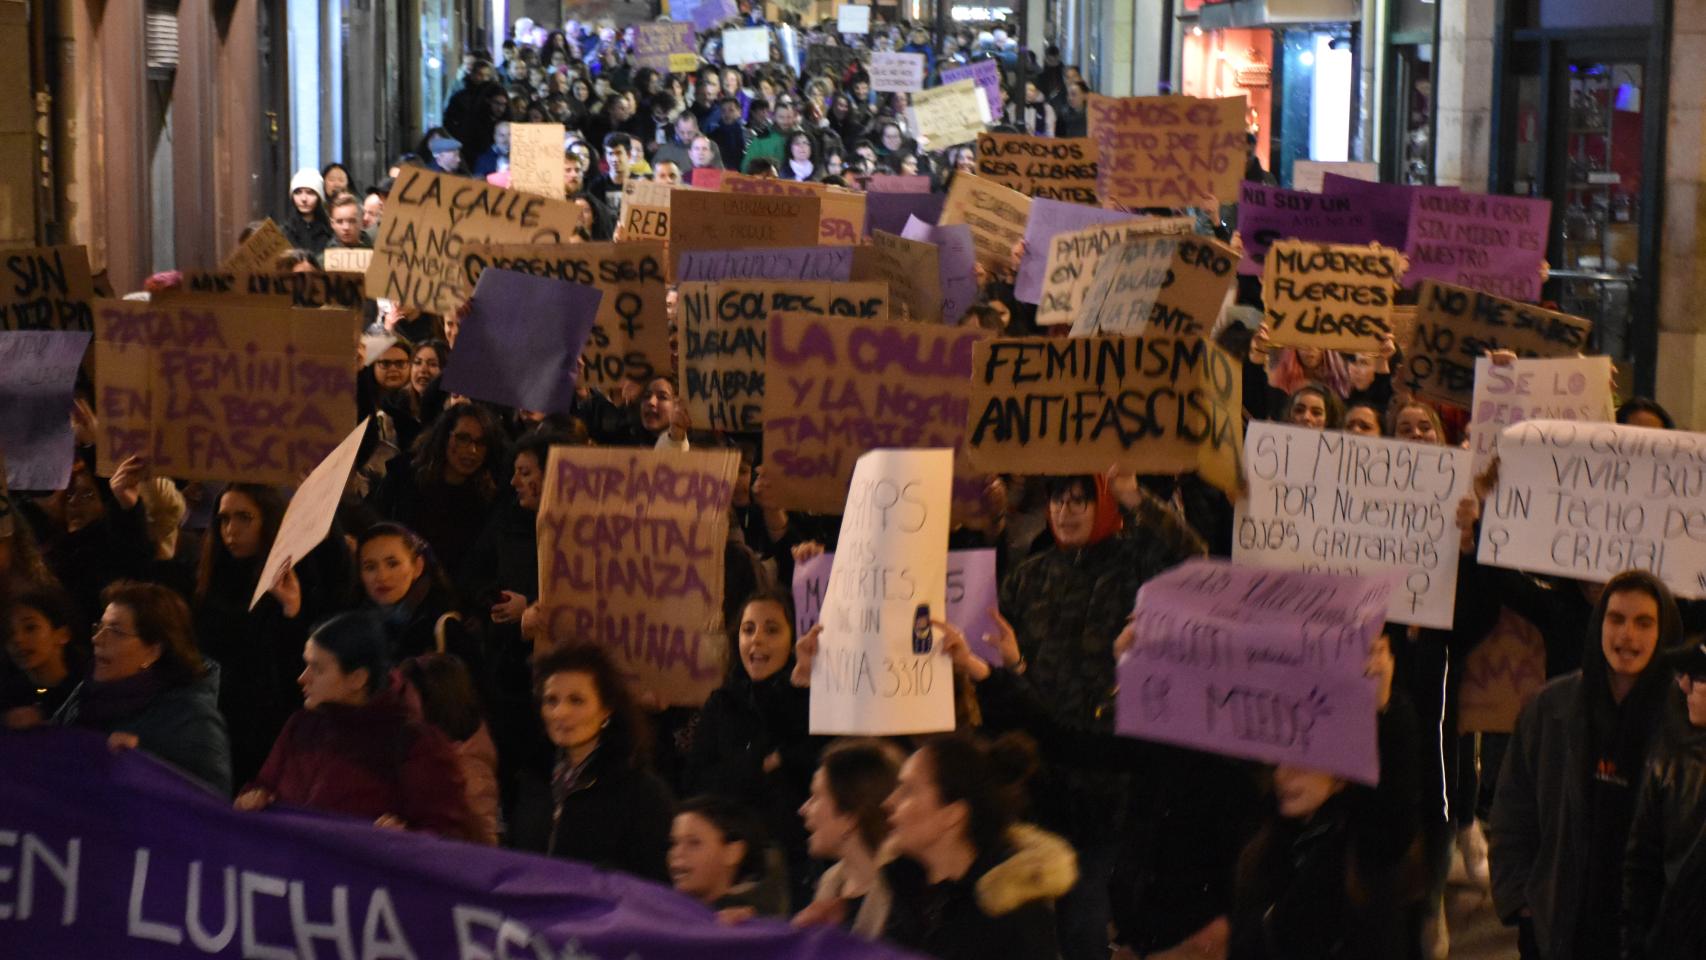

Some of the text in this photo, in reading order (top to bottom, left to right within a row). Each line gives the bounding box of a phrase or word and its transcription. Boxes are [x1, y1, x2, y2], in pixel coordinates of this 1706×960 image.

[978, 136, 1084, 160] QUEREMOS
[1189, 152, 1230, 175] NO
[1025, 162, 1099, 180] LIBRES
[399, 172, 545, 228] LA CALLE
[1241, 189, 1268, 207] NO
[1273, 193, 1315, 212] SOY
[384, 216, 418, 250] LA
[1417, 219, 1449, 243] SIN
[8, 249, 69, 297] SIN
[598, 256, 665, 284] SER
[1273, 278, 1388, 307] FUERTES
[1428, 284, 1467, 317] NO
[769, 312, 837, 367] LA
[1268, 308, 1286, 330] Y
[983, 337, 1234, 402] FEMINISMO
[1486, 364, 1586, 397] SE LO
[103, 386, 150, 422] EN
[166, 392, 215, 422] LA
[787, 376, 816, 408] Y
[818, 377, 868, 412] LA
[556, 456, 731, 512] PATRIARCADO
[1253, 432, 1457, 501] SI MIRASES
[1551, 453, 1631, 496] VIVIR
[547, 503, 714, 559] Y CAPITAL
[1270, 482, 1446, 543] POR NUESTROS
[1495, 485, 1532, 521] UN
[1549, 490, 1645, 536] TECHO
[1239, 517, 1439, 570] OJOS GRITARIAS
[1551, 529, 1665, 578] CRISTAL
[549, 550, 712, 607] ALIANZA
[549, 597, 720, 682] CRIMINAL
[882, 655, 934, 699] 3310
